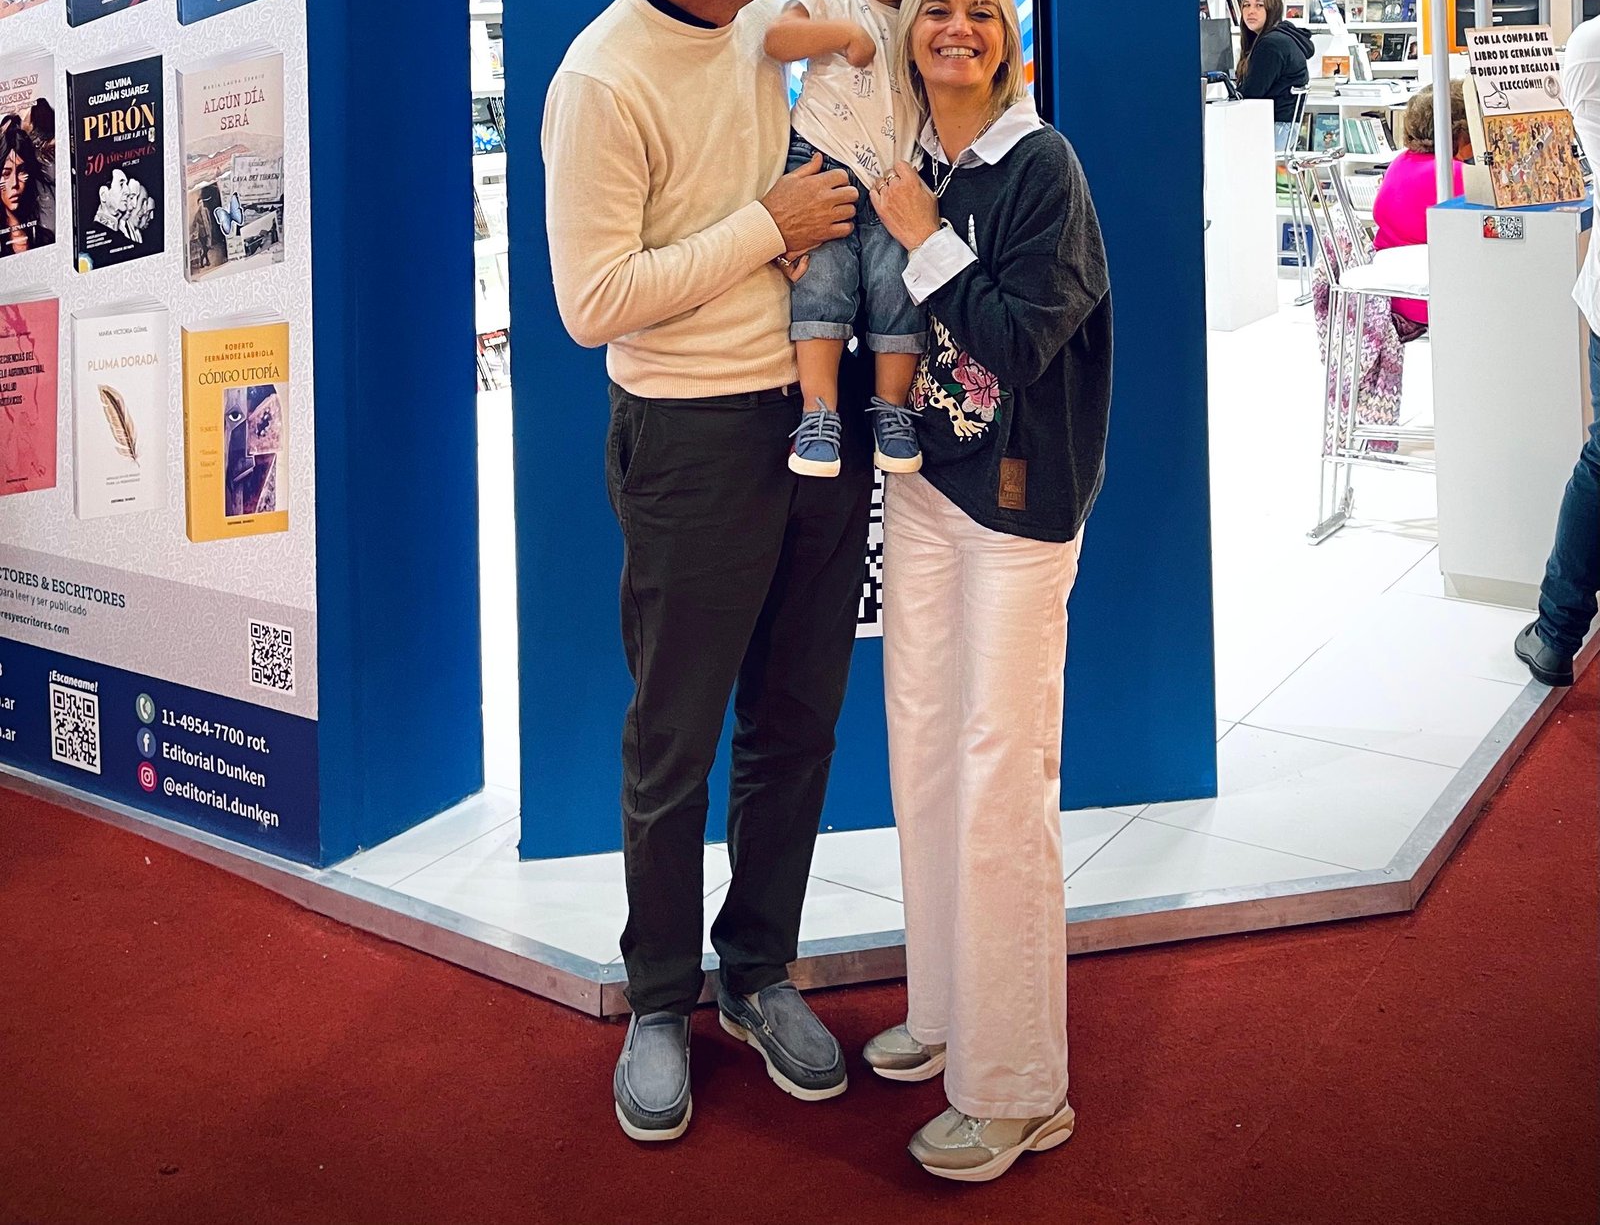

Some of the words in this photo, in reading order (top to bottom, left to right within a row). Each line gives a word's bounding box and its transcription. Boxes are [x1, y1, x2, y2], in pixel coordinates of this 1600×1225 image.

[1474, 35, 1490, 46] CON
[1491, 34, 1501, 45] LA
[1502, 32, 1534, 44] COMPRA
[1535, 31, 1549, 42] DEL
[1474, 50, 1498, 61] LIBRO
[1499, 49, 1509, 59] DE
[1510, 46, 1542, 59] GERMÁN
[1478, 65, 1508, 77] DIBUJO
[1509, 64, 1520, 75] DE
[1520, 62, 1549, 74] REGALO
[88, 90, 120, 106] GUZMÁN
[120, 83, 150, 99] SUAREZ
[105, 76, 132, 91] SILVINA
[203, 90, 241, 115] ALGÚN
[244, 86, 265, 106] DÍA
[82, 98, 156, 142] PERÓN
[220, 108, 250, 131] SERÁ
[85, 152, 104, 176] 50
[204, 351, 242, 363] FERNÁNDEZ
[243, 350, 274, 359] LABRIOLA
[225, 342, 254, 351] ROBERTO
[88, 358, 119, 372] PLUMA
[120, 353, 159, 368] DORADA
[198, 368, 240, 386] CÓDIGO
[241, 362, 280, 381] UTOPÍA
[15, 589, 29, 603] leer
[36, 597, 48, 606] ser
[49, 599, 88, 617] publicado
[41, 576, 49, 591] &
[51, 578, 126, 609] ESCRITORES
[49, 669, 99, 693] ¡Escaneame!
[161, 709, 245, 746] 11-4954-7700
[247, 735, 270, 754] rot.
[162, 741, 215, 773] Editorial
[217, 758, 266, 787] Dunken
[163, 776, 279, 828] @editorial.dunken
